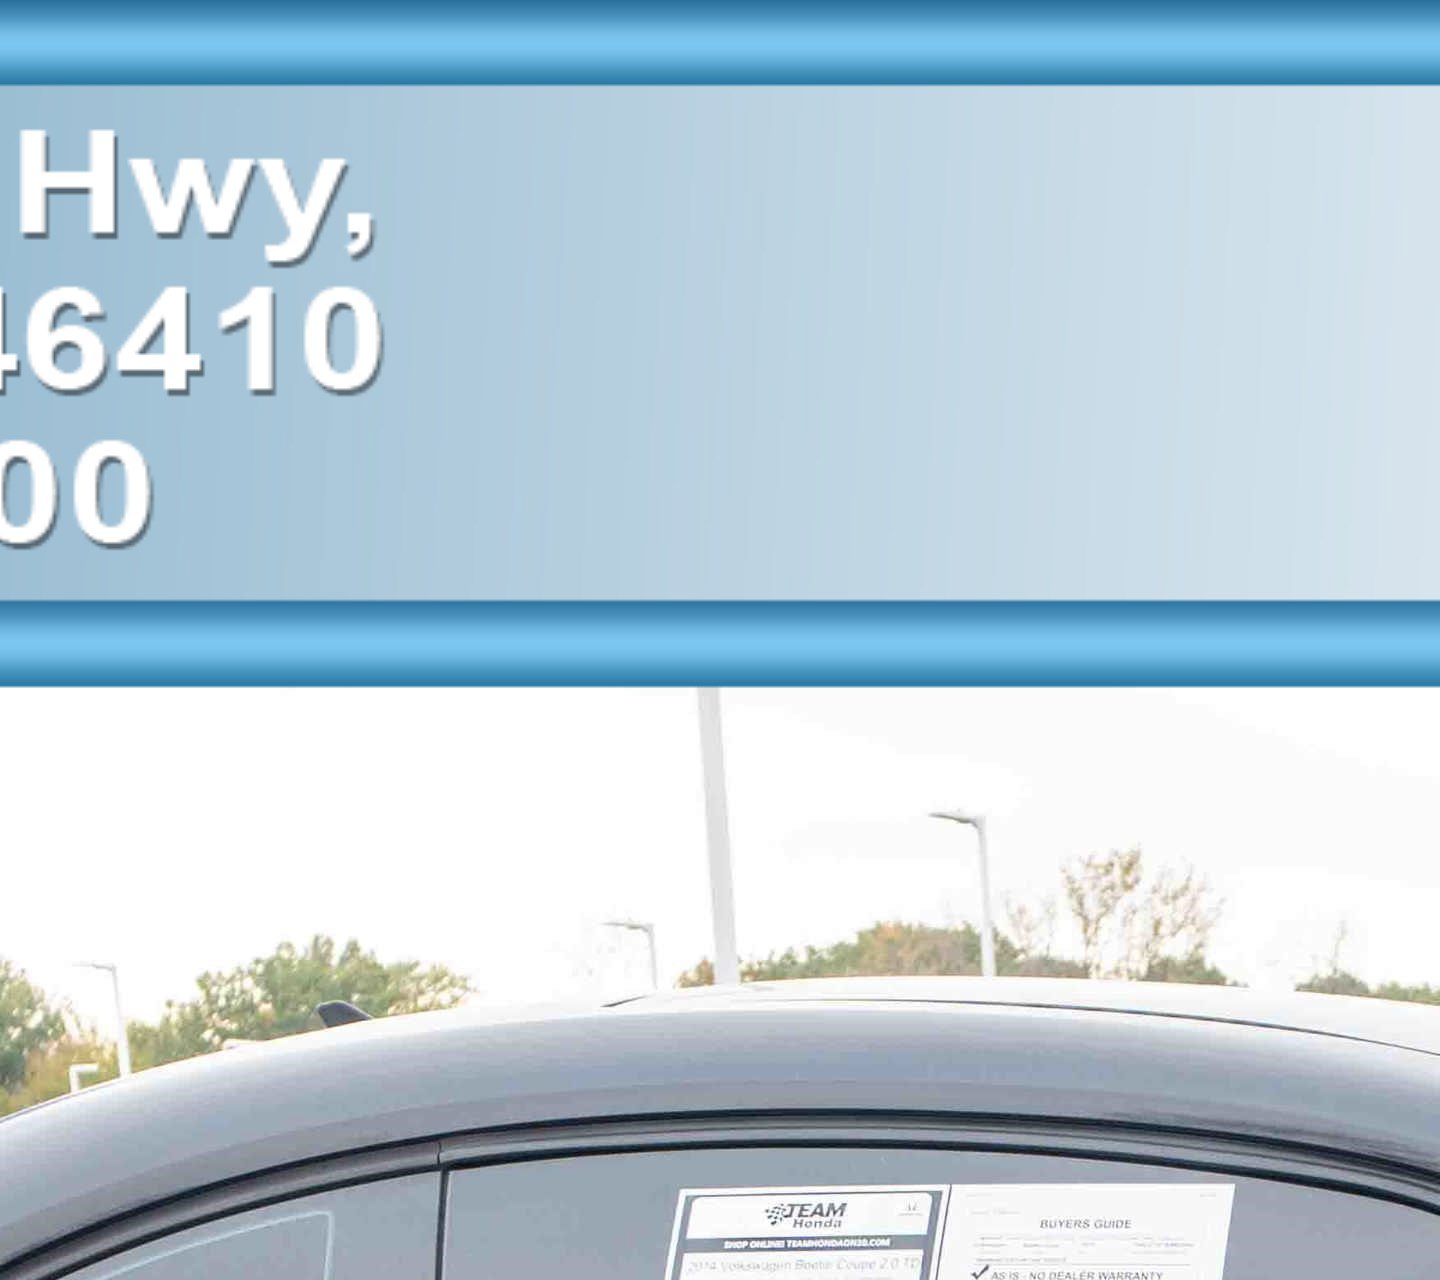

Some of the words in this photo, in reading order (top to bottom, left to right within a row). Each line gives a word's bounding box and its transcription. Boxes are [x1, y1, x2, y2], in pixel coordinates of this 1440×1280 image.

[786, 1202, 847, 1218] TEAM
[792, 1218, 843, 1229] Honda
[1039, 1218, 1091, 1230] BUYERS
[1093, 1218, 1133, 1230] GUIDE
[724, 1240, 748, 1250] SHOP
